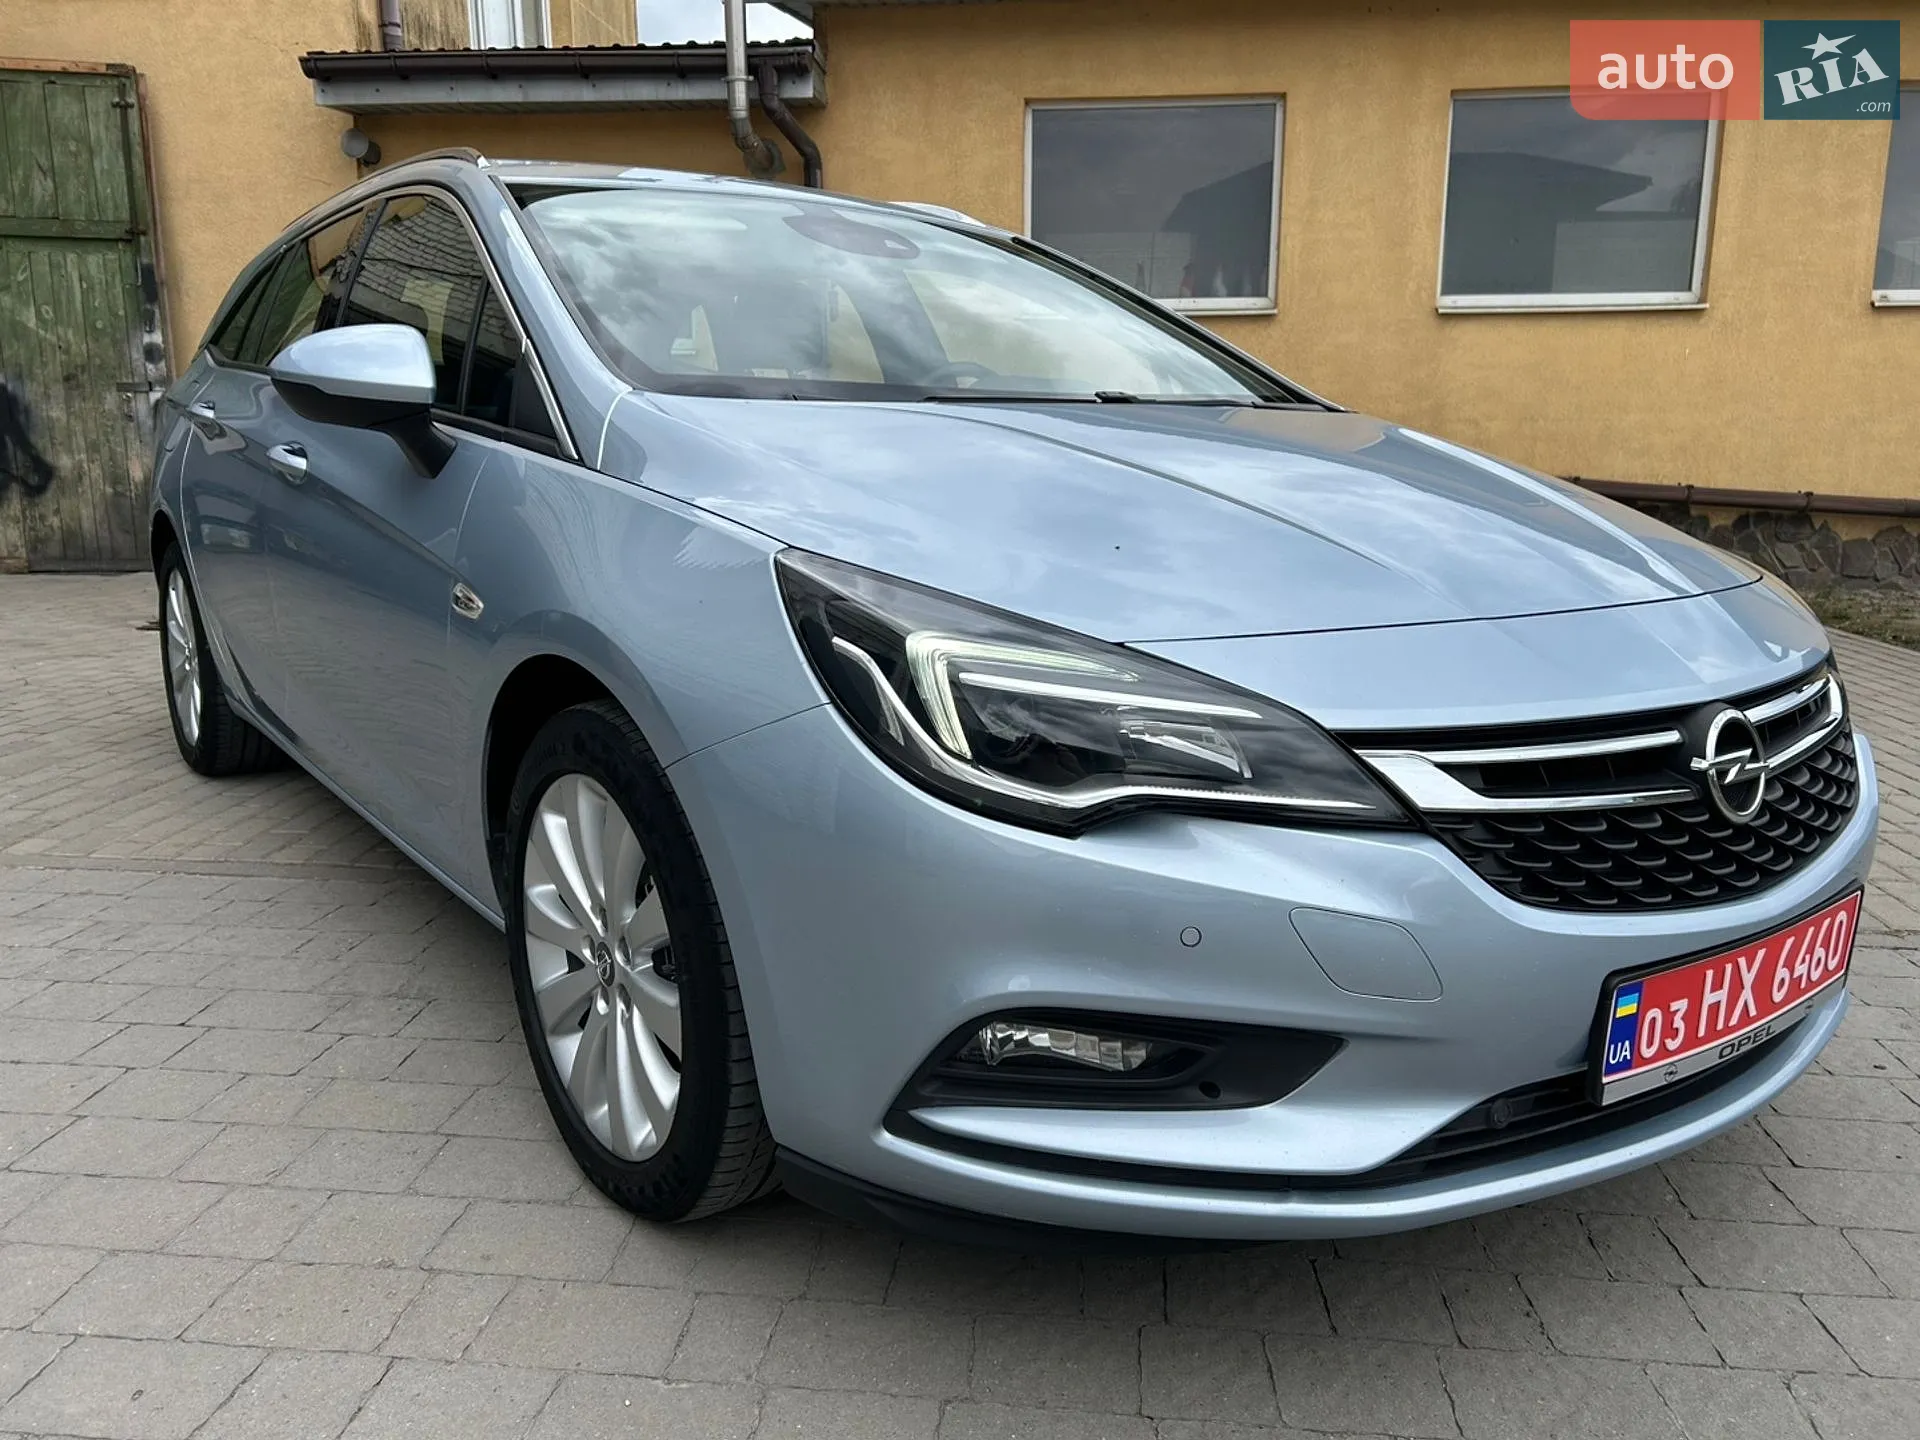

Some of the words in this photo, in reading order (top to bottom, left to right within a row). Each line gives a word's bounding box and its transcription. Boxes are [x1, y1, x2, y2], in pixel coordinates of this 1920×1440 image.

[1639, 998, 1689, 1059] 03
[1697, 948, 1767, 1038] HX
[1771, 910, 1848, 1004] 6460
[1608, 1040, 1632, 1065] UA
[1718, 1024, 1776, 1060] OPEL
